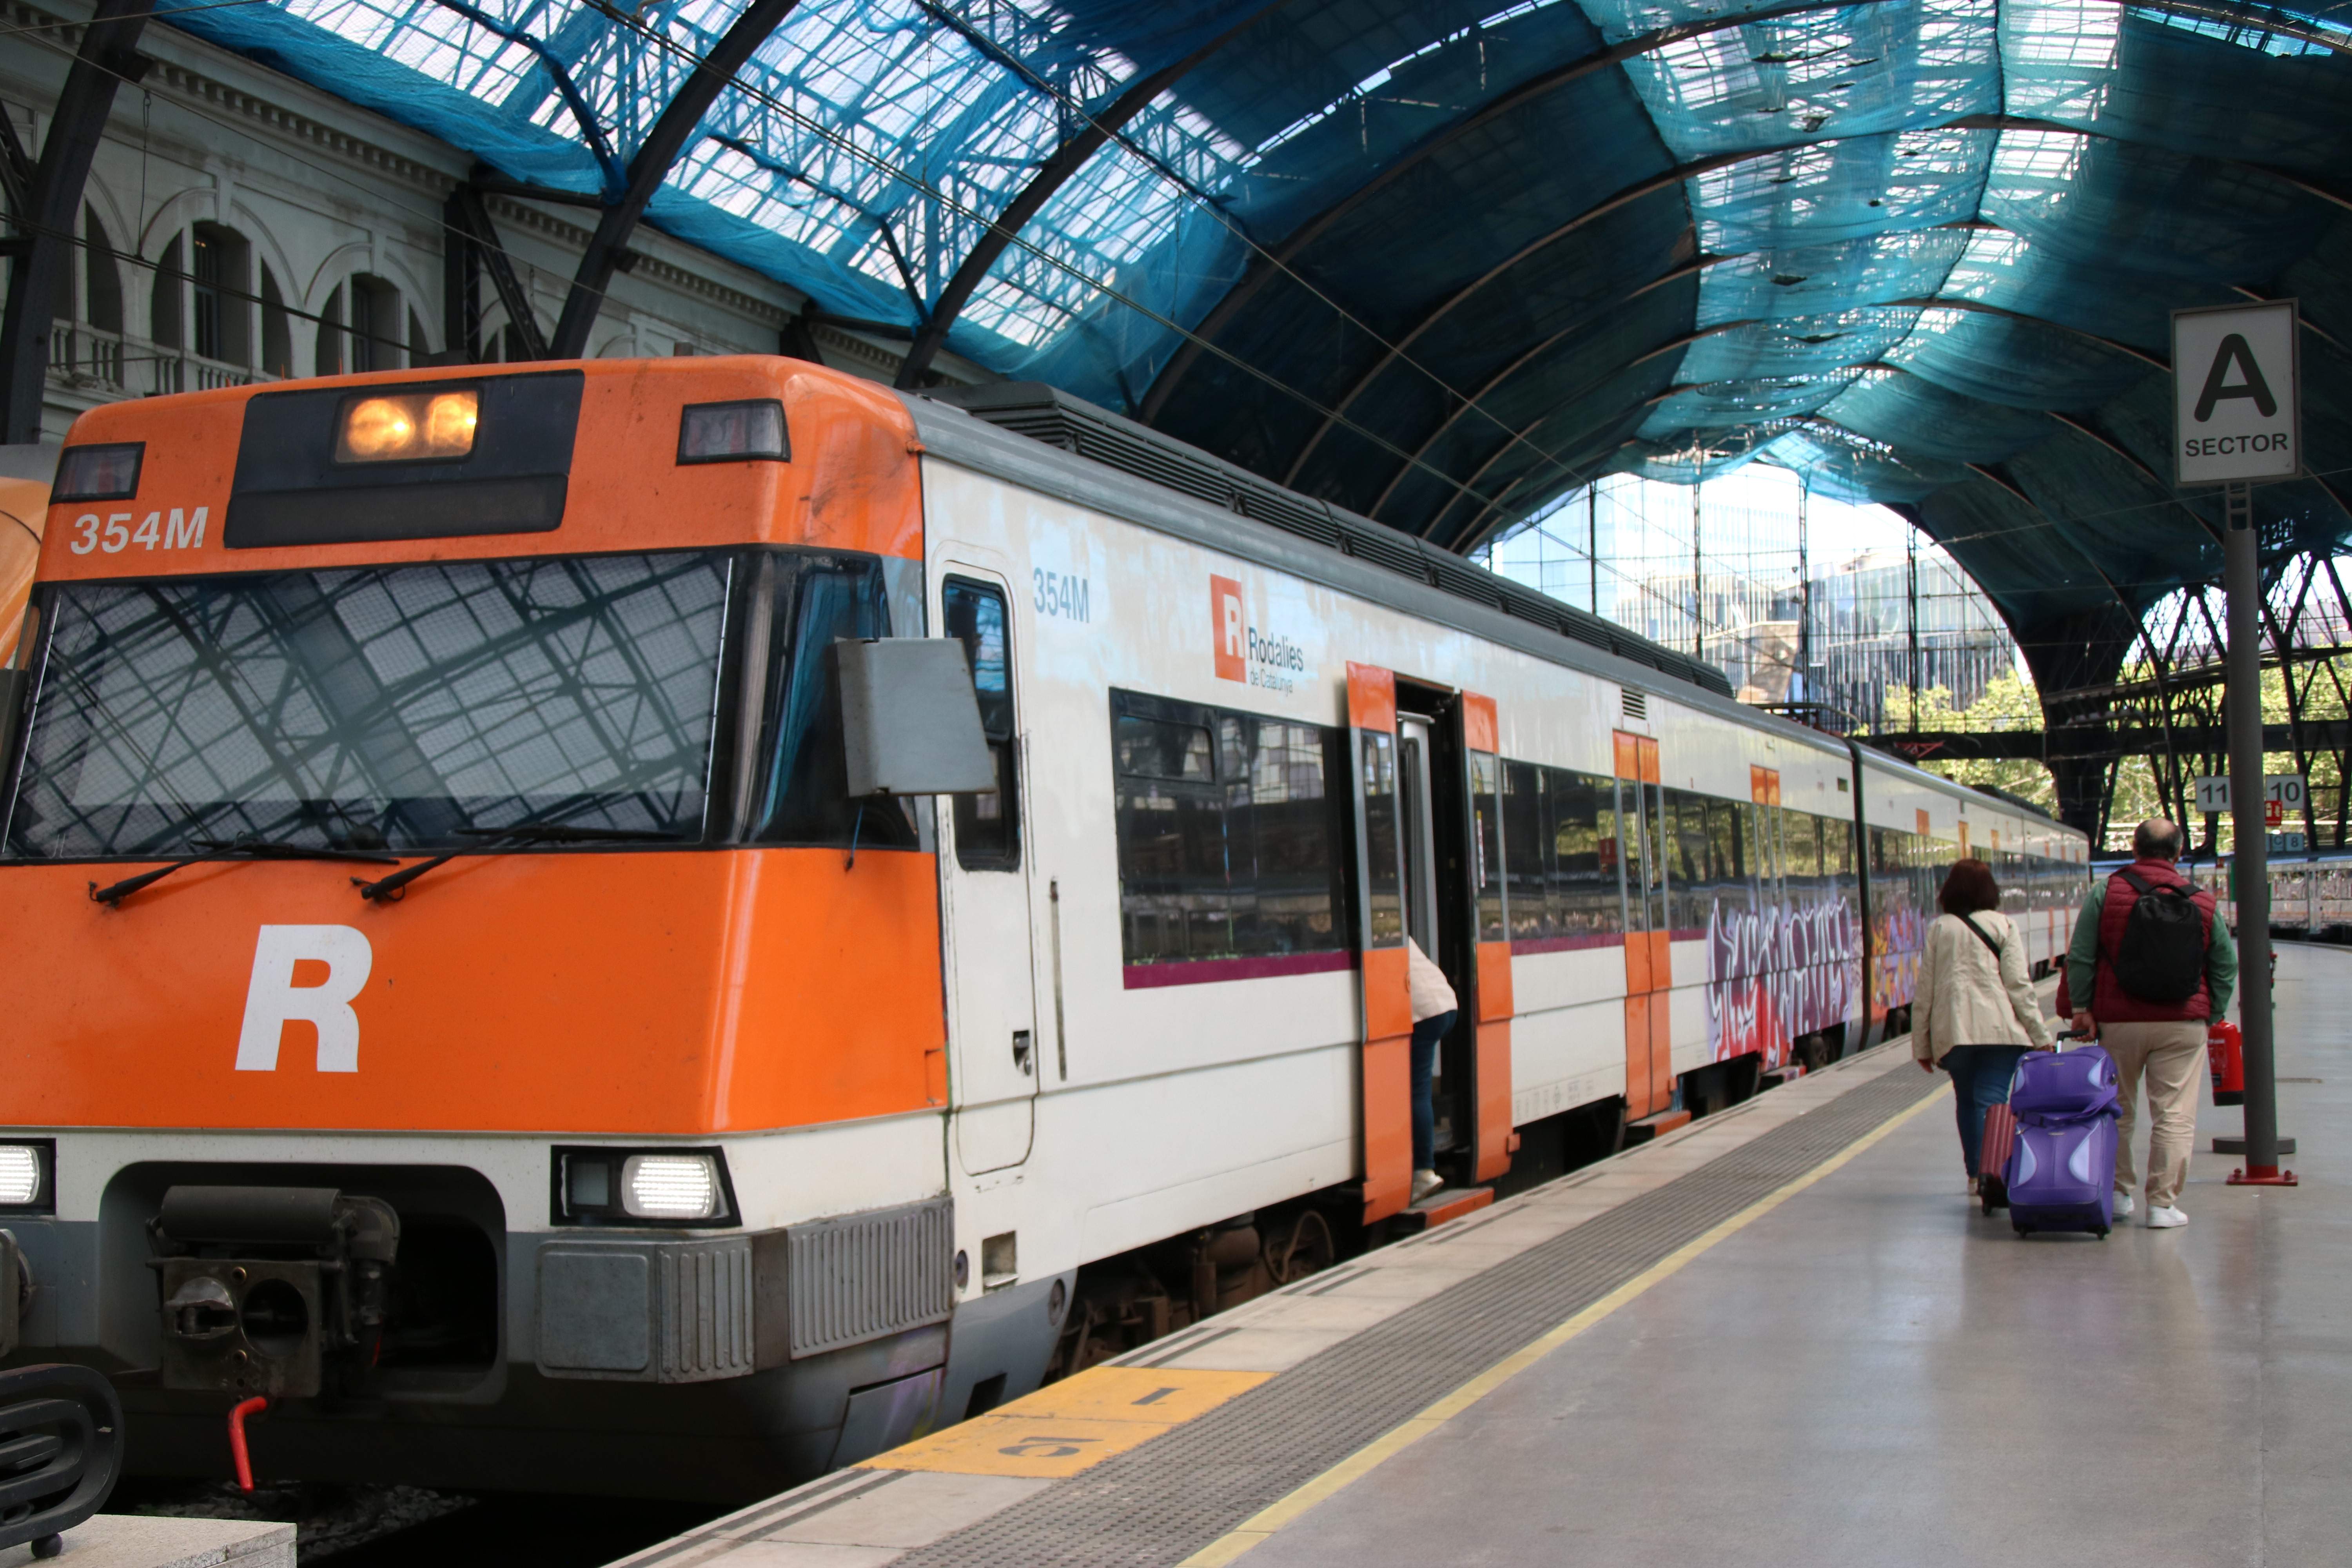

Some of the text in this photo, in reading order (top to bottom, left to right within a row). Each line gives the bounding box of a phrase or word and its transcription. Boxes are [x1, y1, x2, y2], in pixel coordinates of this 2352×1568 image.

[2194, 333, 2277, 422] A
[2185, 433, 2288, 457] SECTOR
[70, 506, 209, 555] 354M
[1033, 567, 1090, 624] 354M
[1223, 593, 1244, 659] R
[1249, 626, 1304, 671] Rodalies
[1250, 667, 1293, 697] de Catalunya
[2201, 783, 2227, 803] 11
[2270, 782, 2300, 802] 10
[2291, 837, 2298, 847] 8
[235, 924, 372, 1073] R
